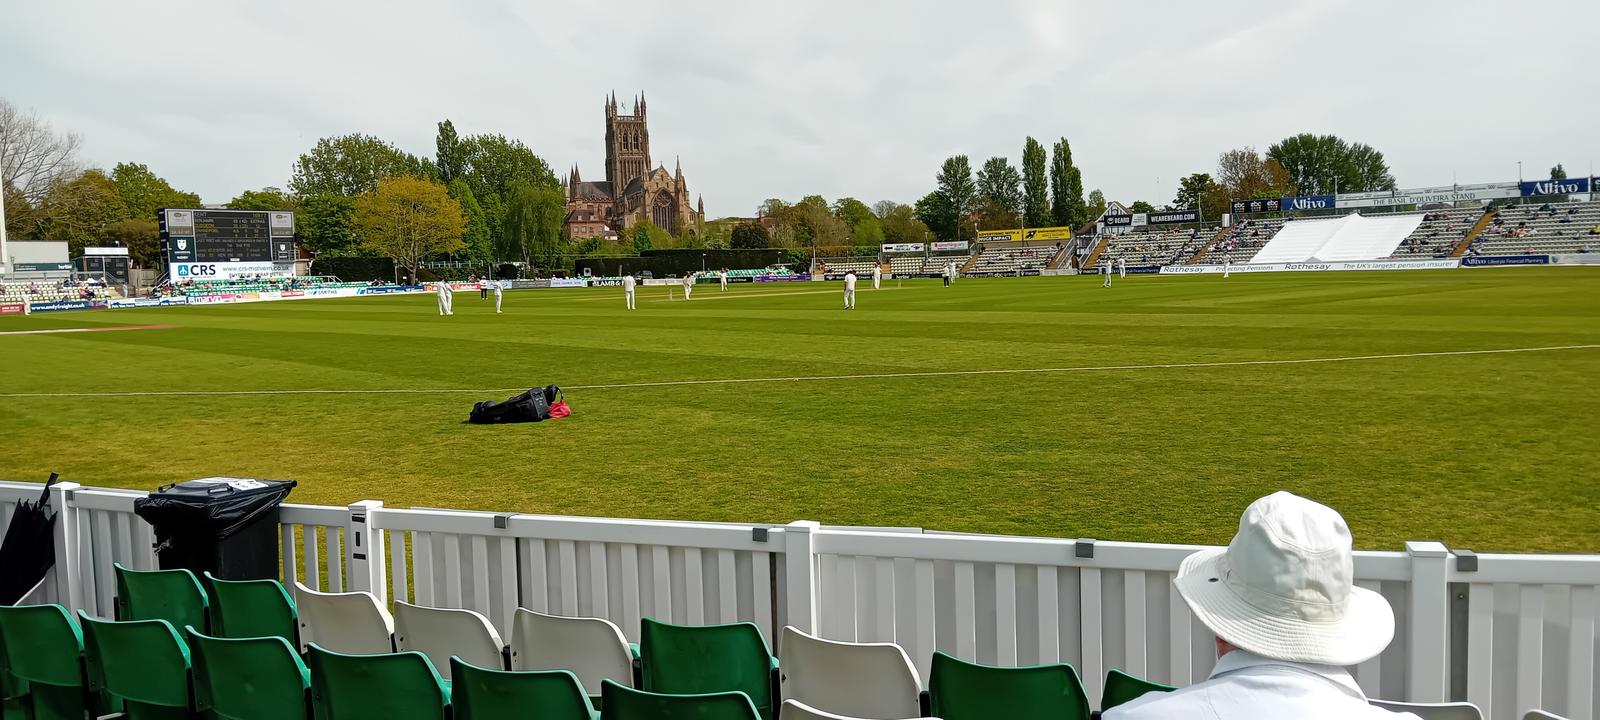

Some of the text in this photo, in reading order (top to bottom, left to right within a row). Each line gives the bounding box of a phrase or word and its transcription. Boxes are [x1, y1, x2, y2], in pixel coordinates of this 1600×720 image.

[1410, 195, 1449, 203] D'OLIVEIRA
[1151, 213, 1195, 222] WEAREBEARD.COM
[190, 264, 216, 276] CRS
[1284, 263, 1331, 271] Rothesay
[1372, 262, 1396, 270] largest
